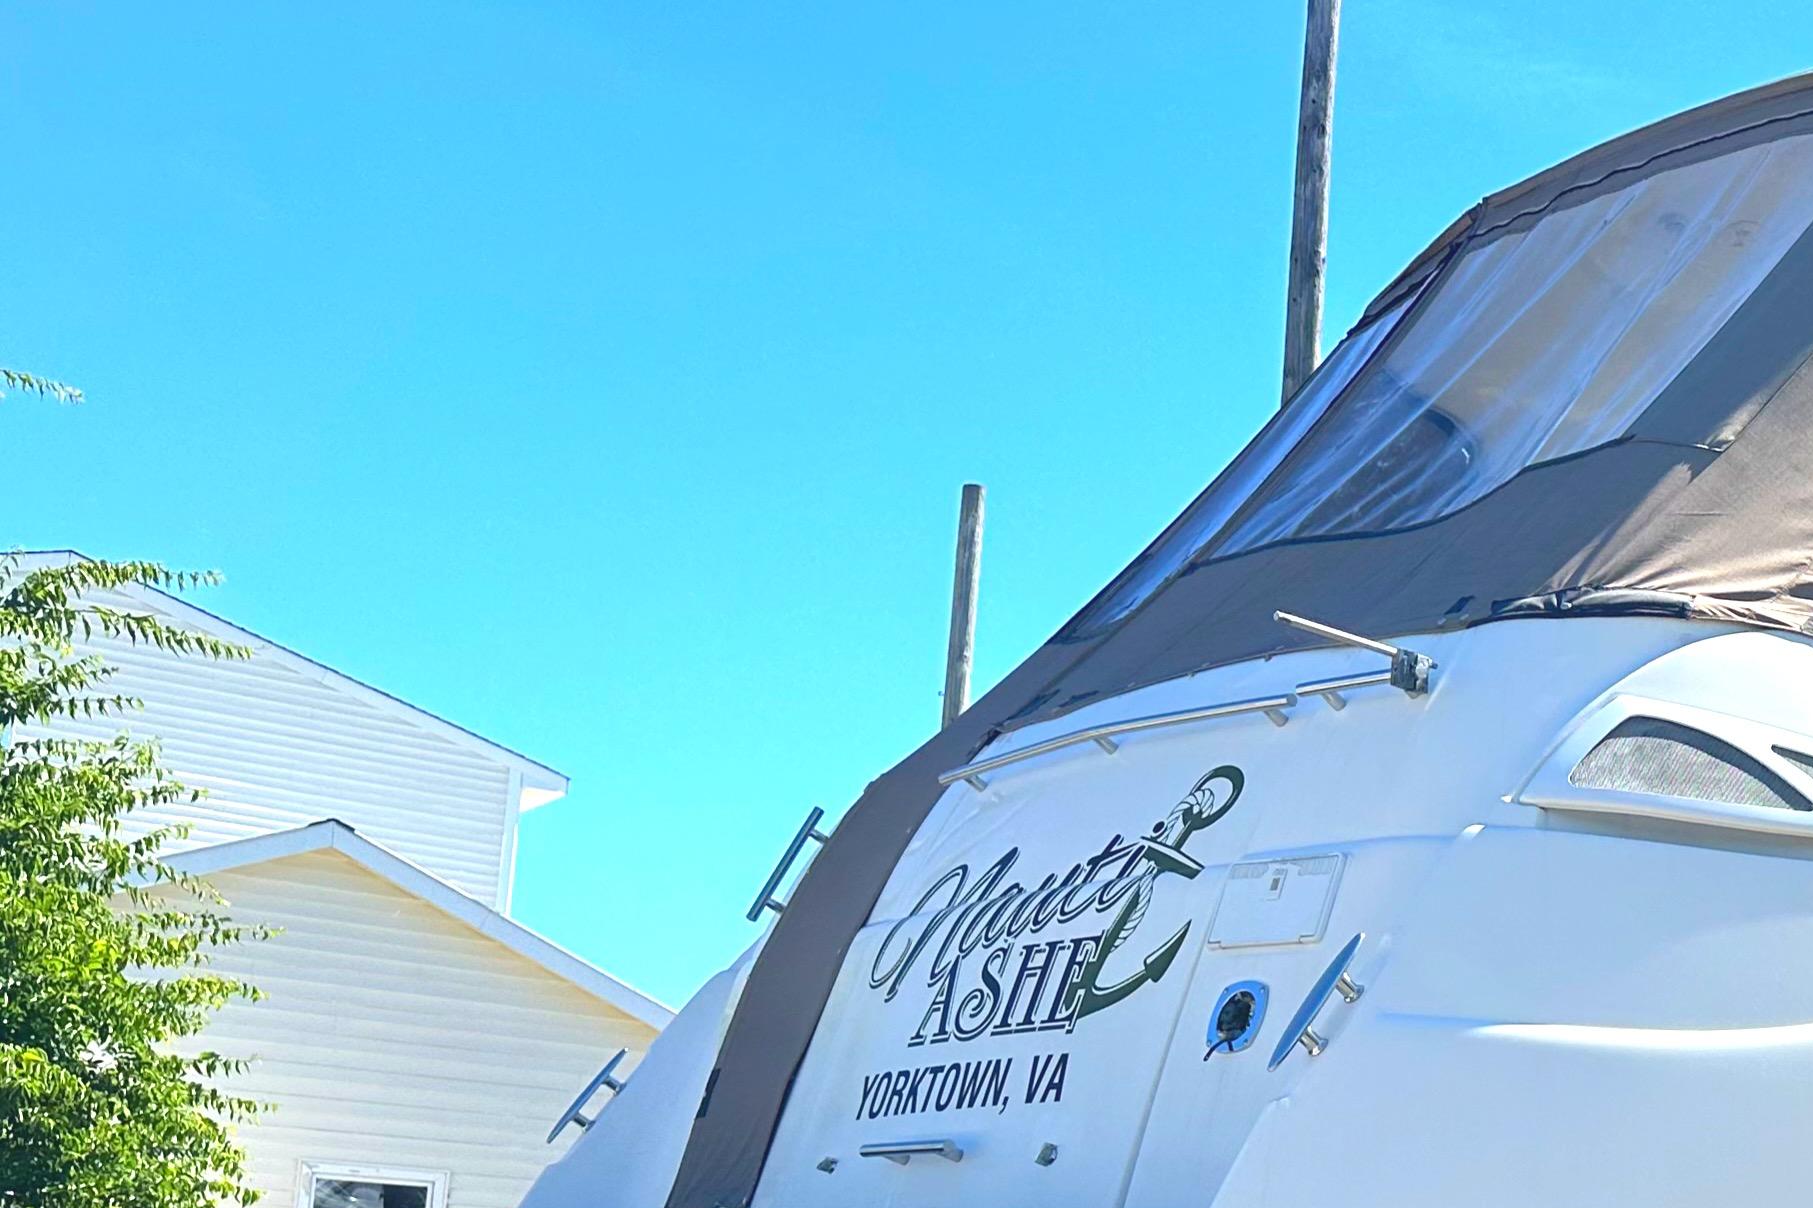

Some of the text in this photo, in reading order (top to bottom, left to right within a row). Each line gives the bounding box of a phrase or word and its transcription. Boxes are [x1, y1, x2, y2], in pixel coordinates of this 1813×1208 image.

[868, 821, 1167, 1003] Nauti
[907, 929, 1106, 1048] ASHE
[855, 1052, 1069, 1121] YORKTOWN, VA
